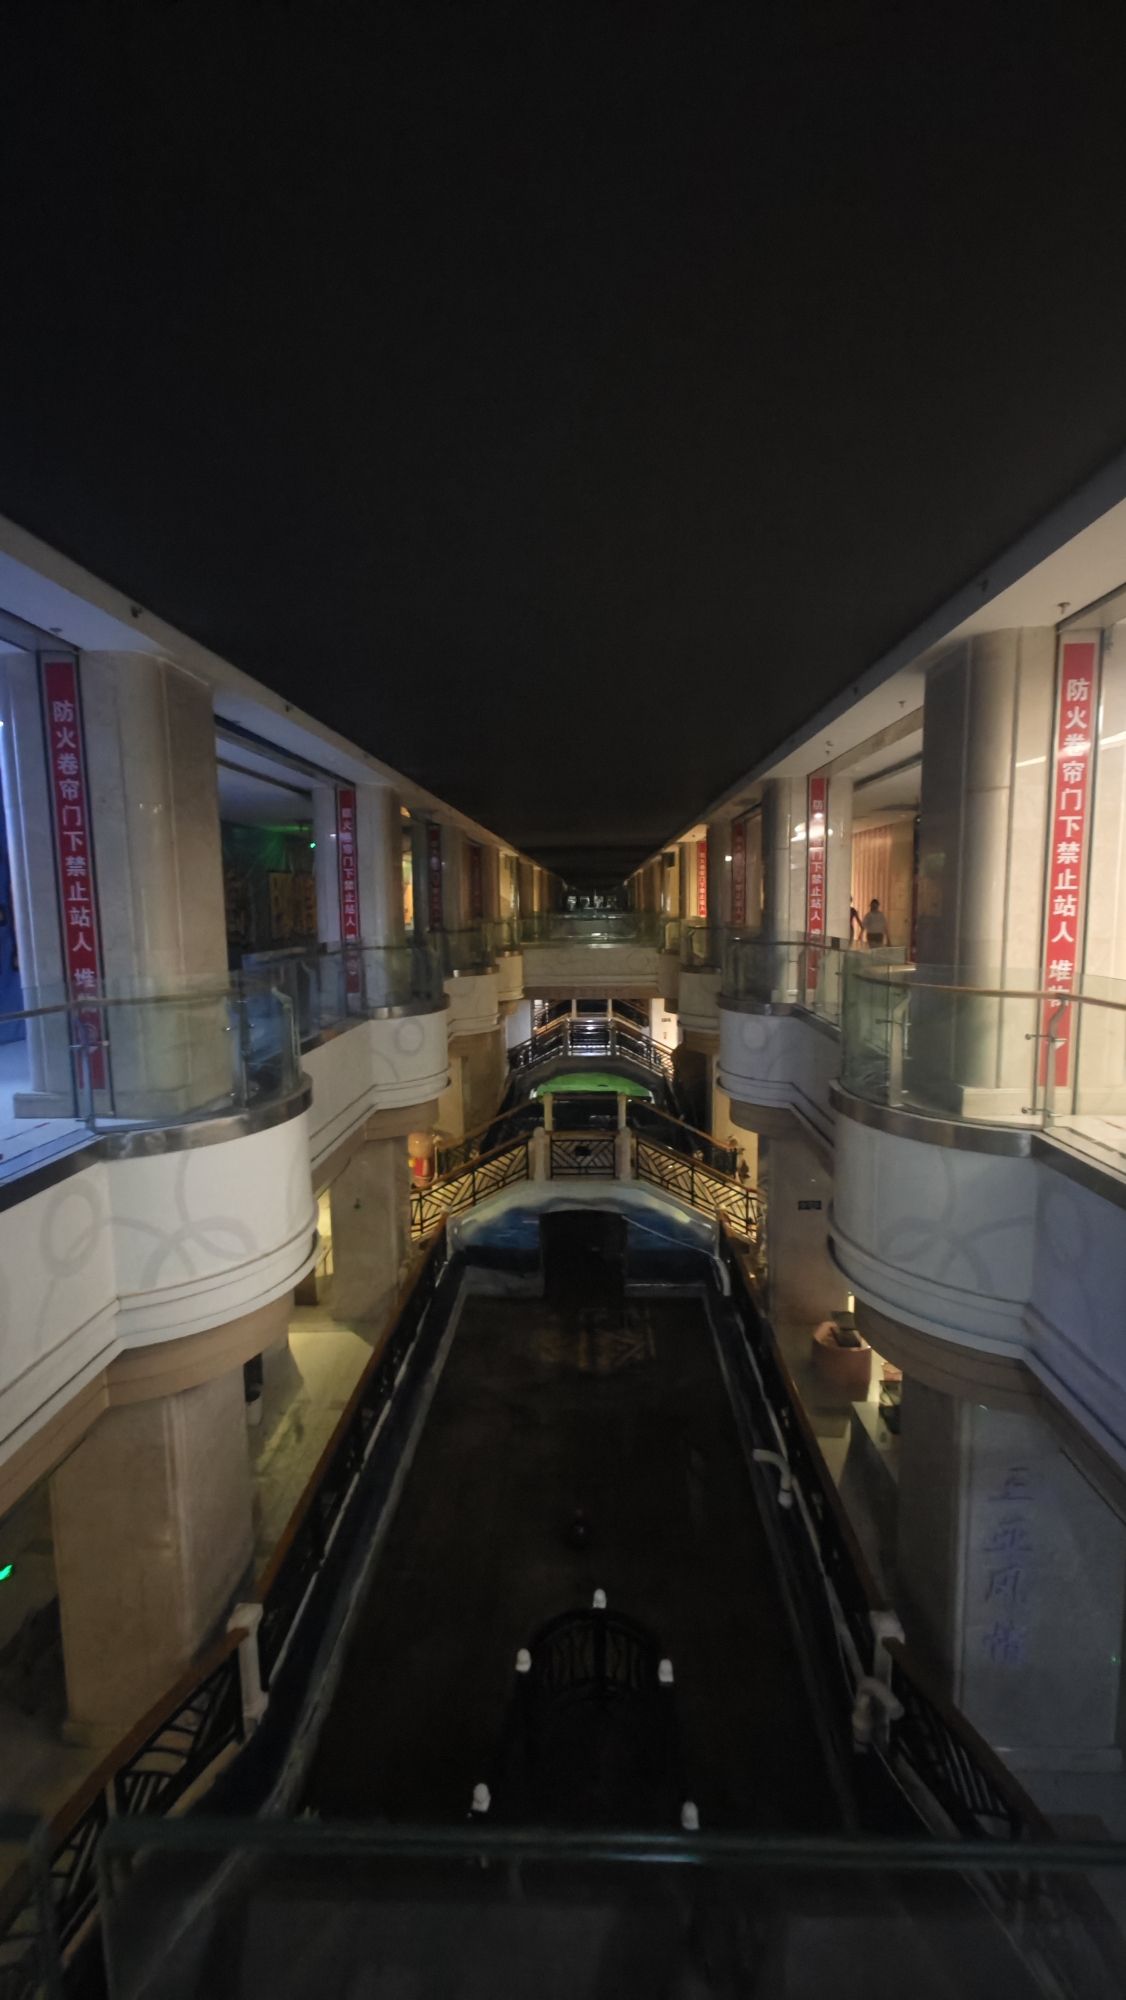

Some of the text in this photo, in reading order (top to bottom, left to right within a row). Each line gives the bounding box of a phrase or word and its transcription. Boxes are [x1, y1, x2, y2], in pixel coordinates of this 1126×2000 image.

[52, 699, 93, 953] 防火卷帘门下禁止站人
[1051, 677, 1090, 944] 防火卷帘门下禁止站人
